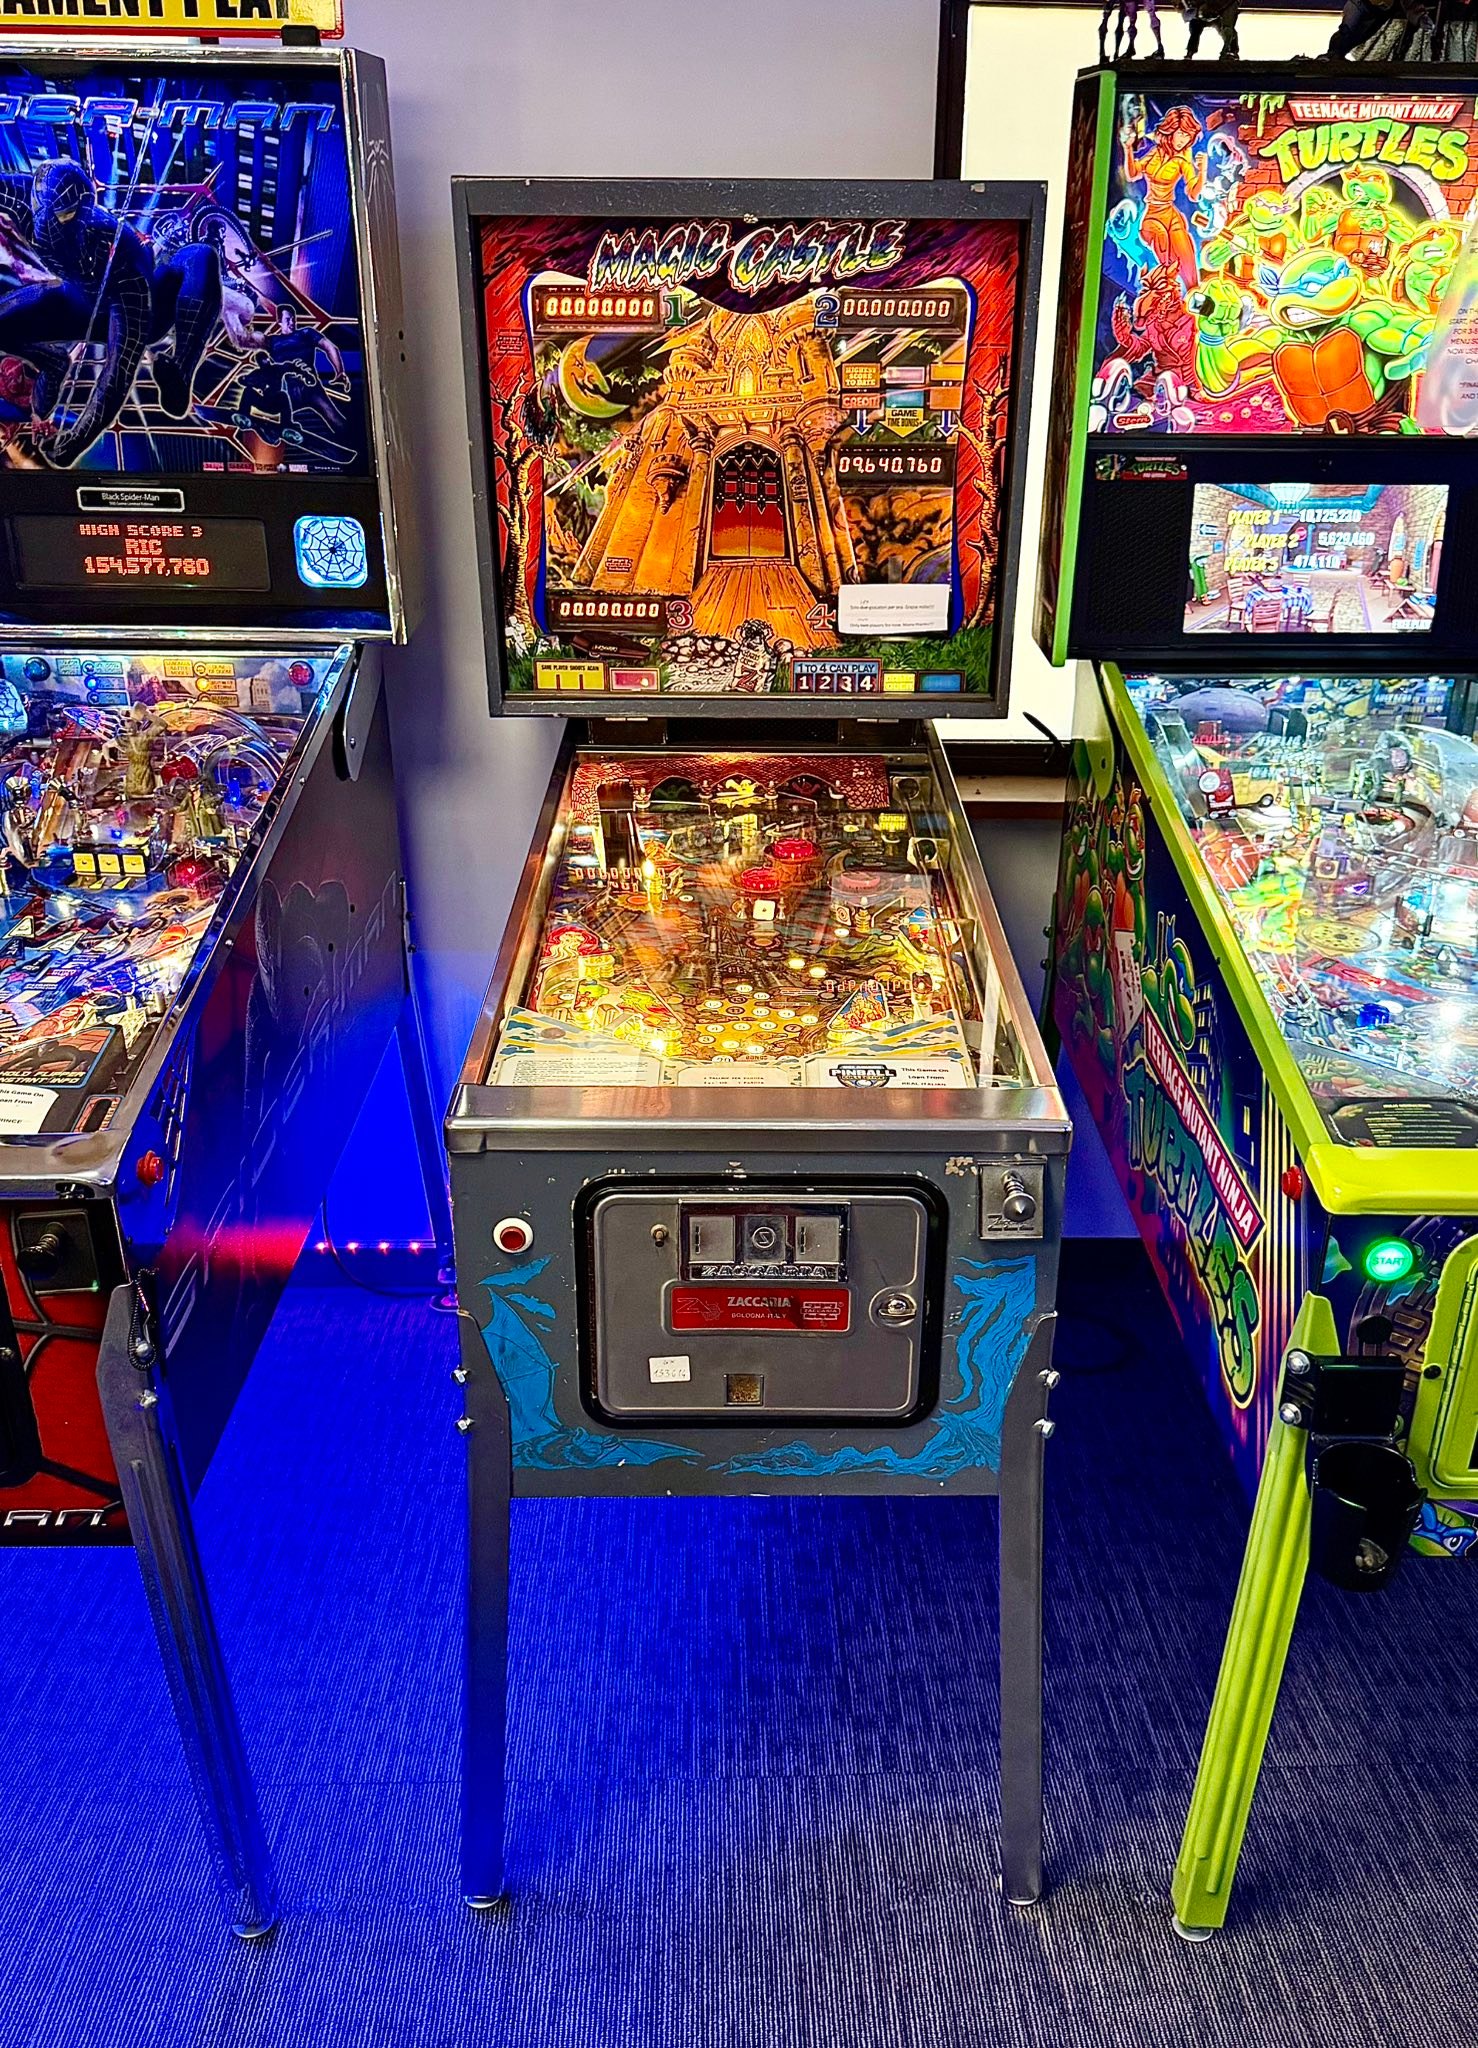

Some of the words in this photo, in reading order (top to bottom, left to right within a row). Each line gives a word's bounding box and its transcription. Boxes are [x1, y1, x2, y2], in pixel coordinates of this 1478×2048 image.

[1292, 102, 1358, 119] TEENAGE
[1359, 103, 1413, 119] MUTANT
[1410, 103, 1457, 119] NINJA
[1259, 118, 1470, 184] TURTLES
[588, 218, 730, 292] MAGIC
[730, 219, 906, 291] CASTLE
[663, 294, 689, 326] 1
[814, 294, 841, 328] 2
[890, 408, 918, 418] GAME
[1118, 416, 1151, 426] Stern
[1329, 418, 1349, 435] L
[101, 492, 120, 501] Black
[120, 492, 161, 502] Spider-Man
[1227, 510, 1271, 526] PLAYER
[1271, 510, 1281, 526] 1
[79, 524, 120, 536] HIGH
[126, 524, 185, 537] SCORE
[190, 525, 204, 538] 3
[124, 538, 163, 556] RIC
[1243, 534, 1287, 549] PLAYER
[1287, 533, 1300, 548] 2
[84, 556, 210, 577] 154,577,780
[1223, 556, 1266, 572] PLAYER
[668, 599, 694, 629] 3
[806, 602, 837, 632] 4
[805, 664, 818, 673] TO
[819, 663, 828, 673] 4
[829, 664, 850, 673] CAN
[851, 664, 876, 673] PLAY
[799, 675, 810, 690] 1
[818, 675, 832, 690] 2
[841, 675, 853, 692] 3
[859, 675, 874, 691] 4
[831, 1068, 896, 1078] PINBALL
[1146, 1013, 1183, 1109] TEENAGE
[1181, 1088, 1222, 1173] MUTANT
[1216, 1160, 1255, 1239] NINJA
[1123, 1055, 1259, 1402] TURTLES
[1372, 1256, 1409, 1266] START
[727, 1296, 791, 1308] ZACCARIA
